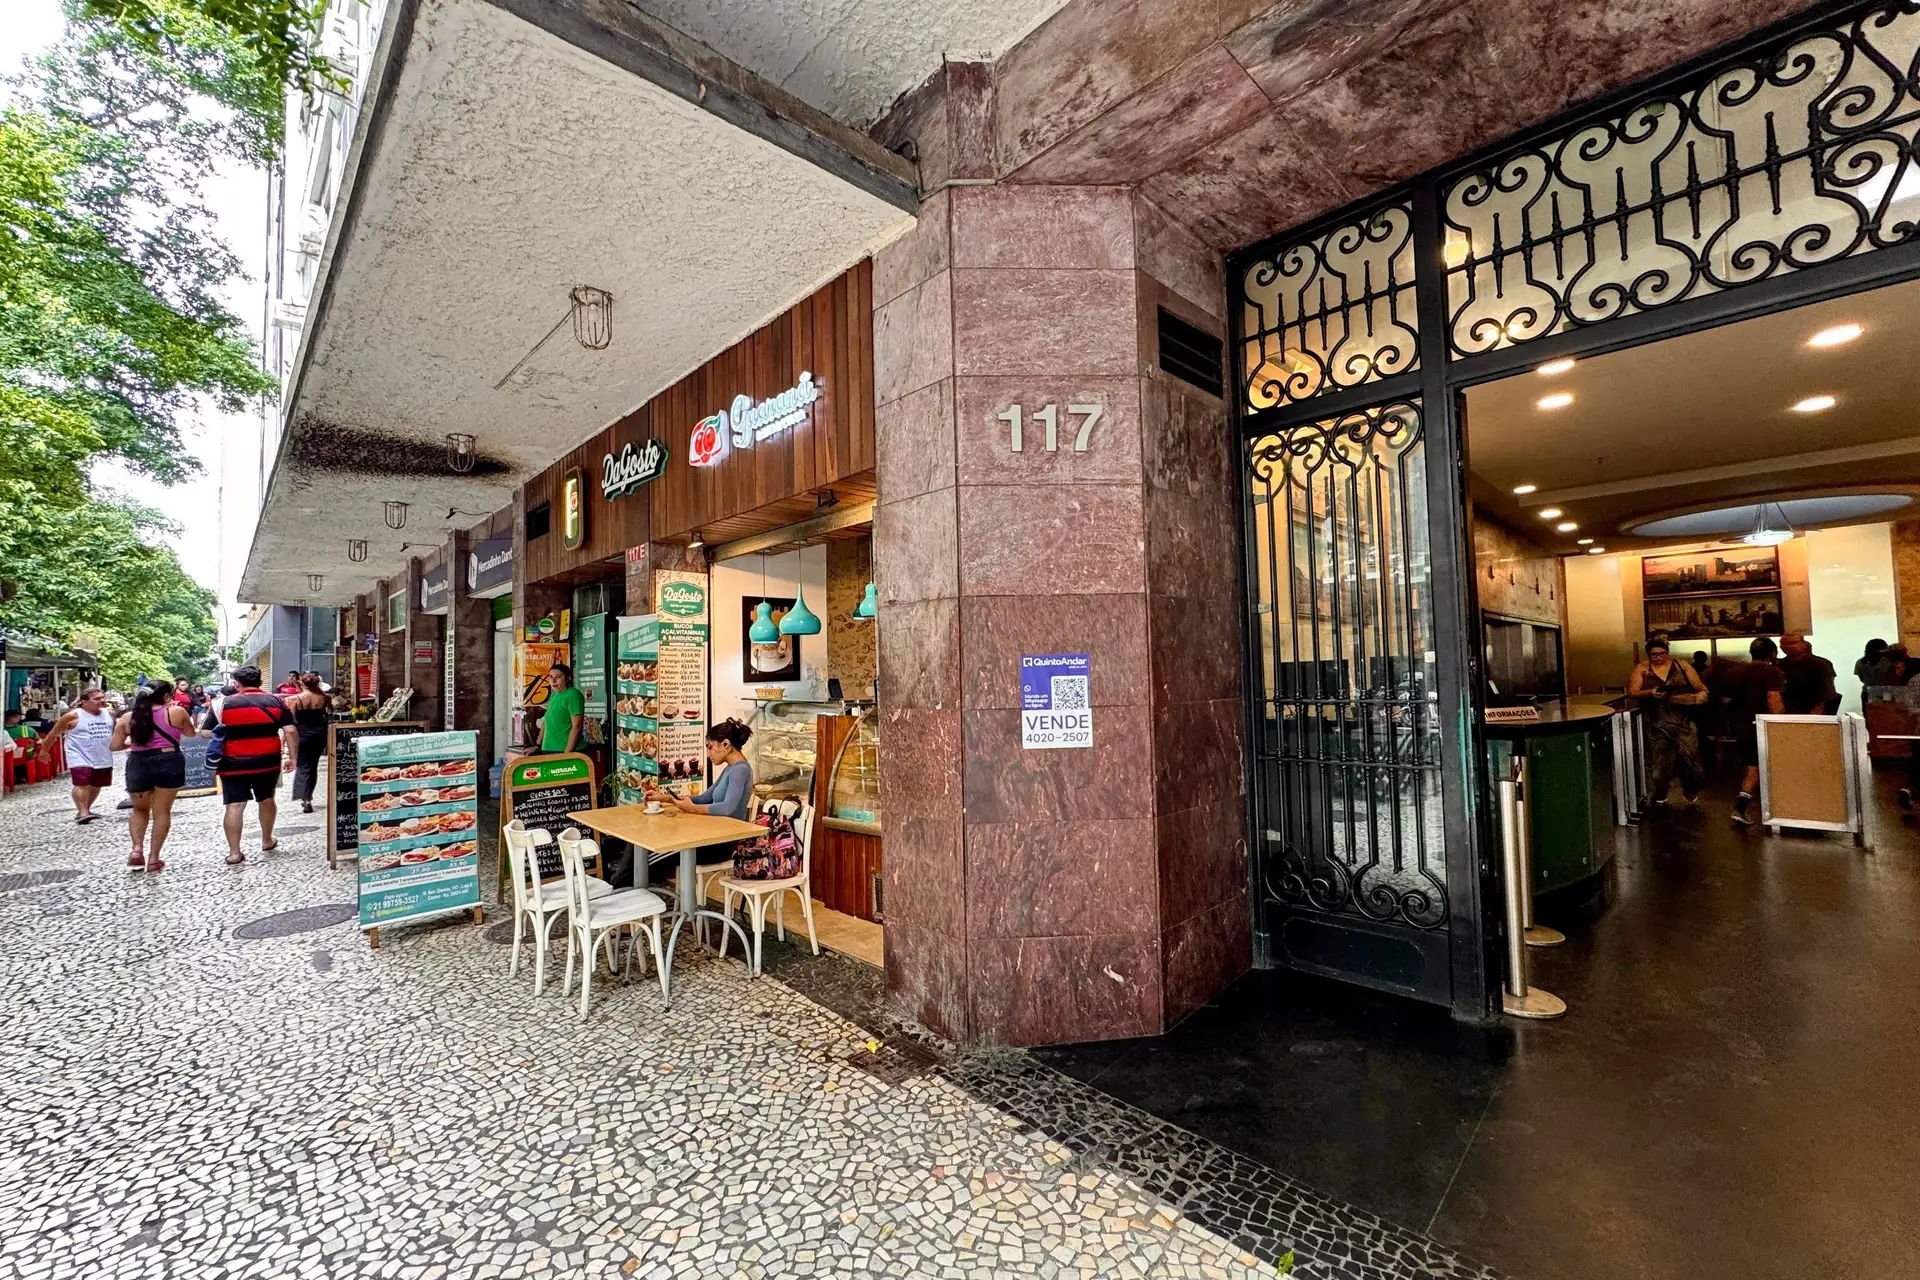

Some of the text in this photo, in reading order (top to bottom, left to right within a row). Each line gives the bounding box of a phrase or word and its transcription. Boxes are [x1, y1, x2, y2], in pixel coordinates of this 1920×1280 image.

[731, 371, 818, 449] Guaraná
[998, 404, 1103, 452] 117
[602, 439, 661, 492] DaGosto
[663, 587, 703, 602] DaGosto
[1033, 657, 1087, 666] QuintoAndar
[1026, 715, 1089, 730] VENDE
[1026, 732, 1089, 743] 4020-2507
[373, 902, 381, 910] 21
